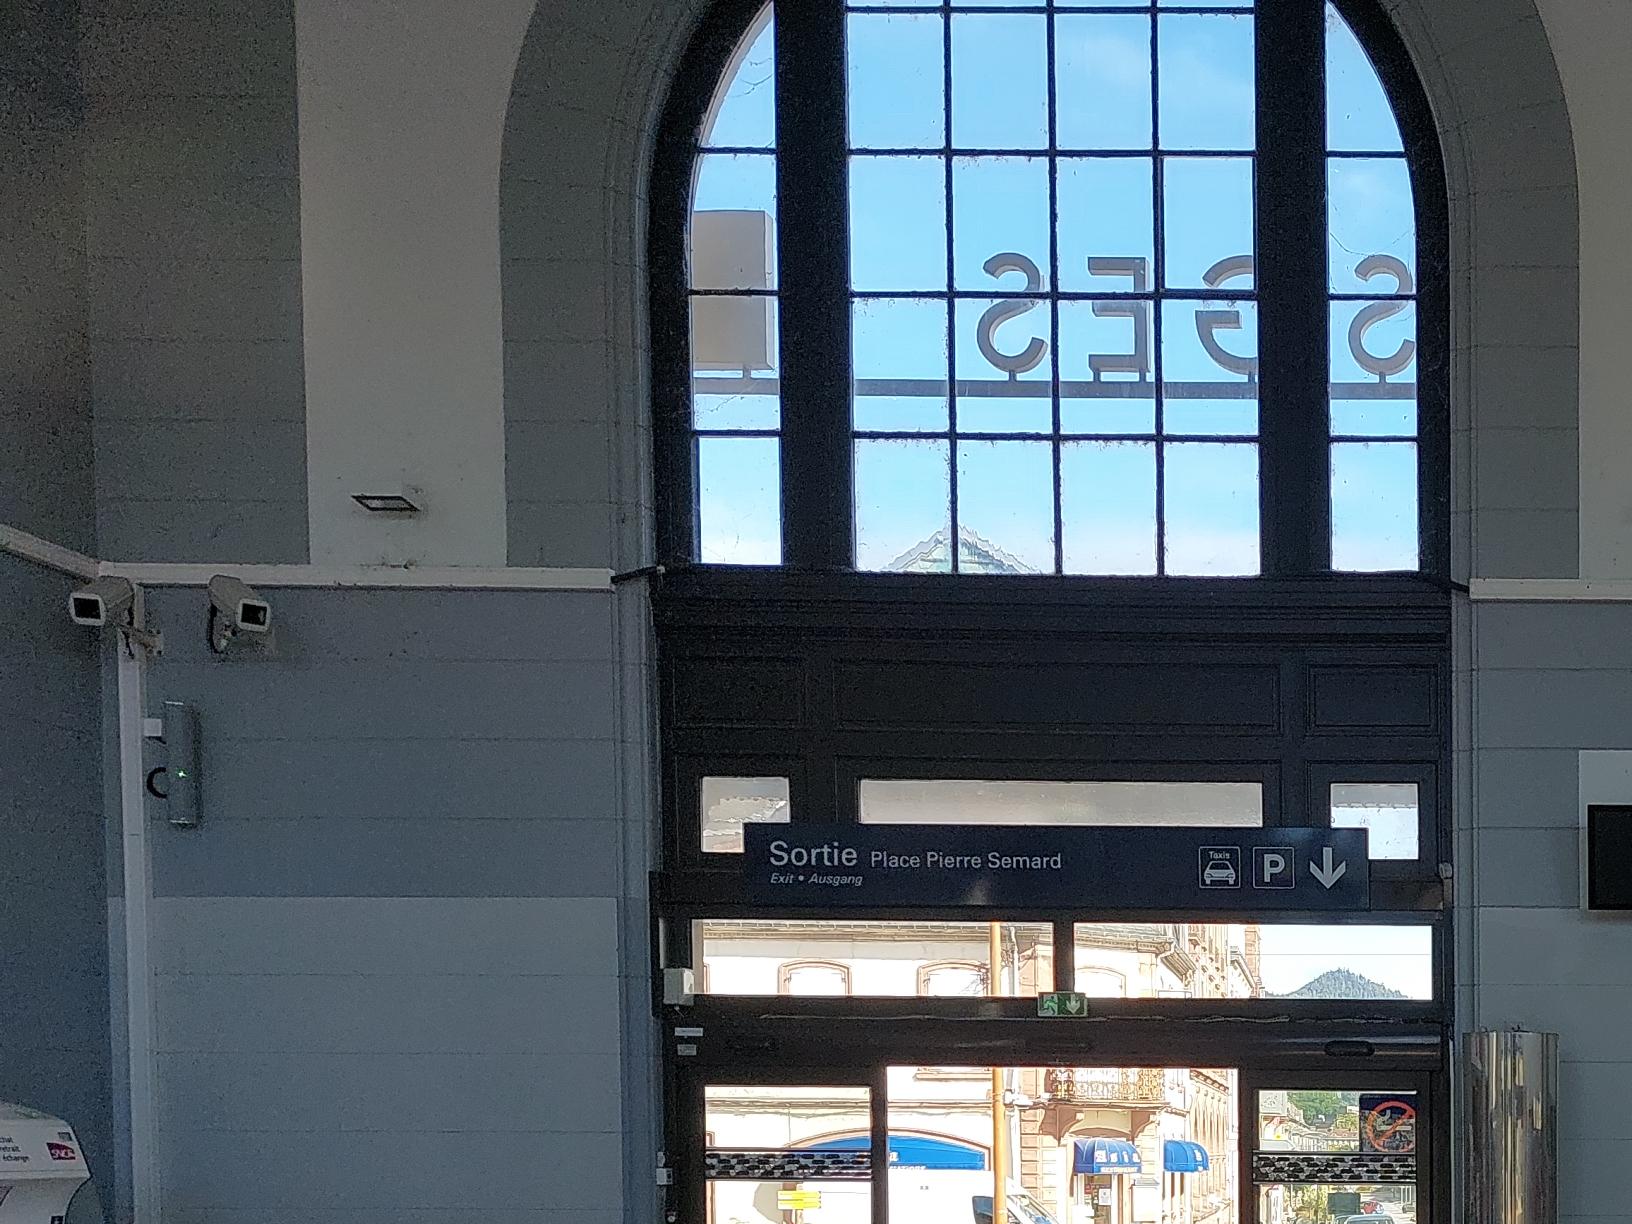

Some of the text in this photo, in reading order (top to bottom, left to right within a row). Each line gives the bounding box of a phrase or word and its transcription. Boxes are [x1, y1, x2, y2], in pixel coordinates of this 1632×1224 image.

[769, 840, 1062, 869] Sortie Place Pierre Semard
[1208, 851, 1230, 859] Taxis
[1264, 854, 1285, 882] P
[770, 873, 863, 887] Exit Ausgang
